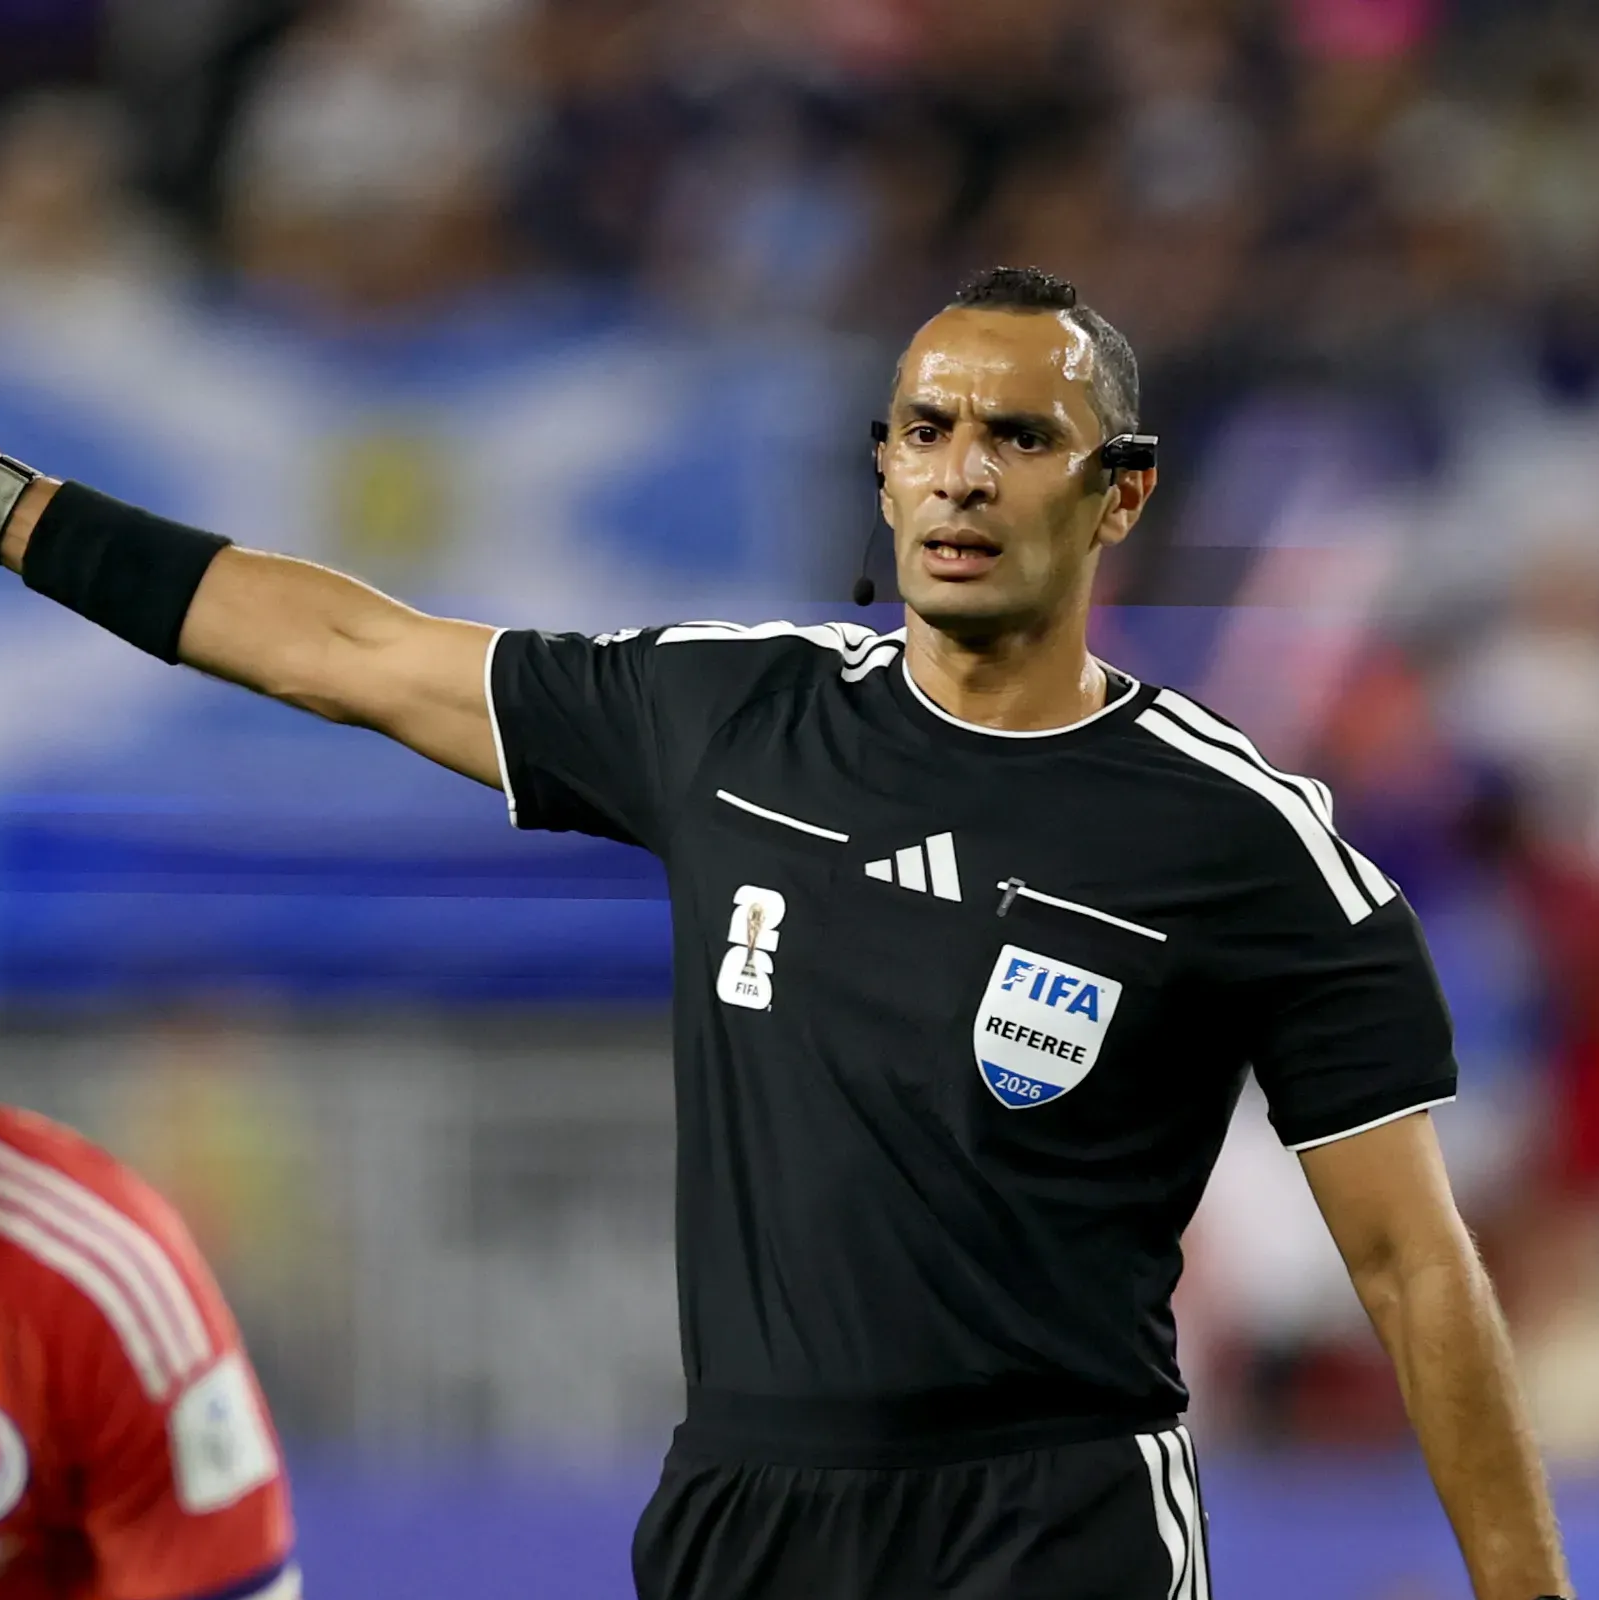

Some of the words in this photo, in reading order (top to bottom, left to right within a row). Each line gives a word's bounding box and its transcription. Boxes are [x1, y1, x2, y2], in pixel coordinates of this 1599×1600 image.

[735, 982, 759, 998] FIFA
[1000, 957, 1100, 1023] FIFA
[985, 1015, 1087, 1065] REFEREE
[995, 1072, 1043, 1100] 2026
